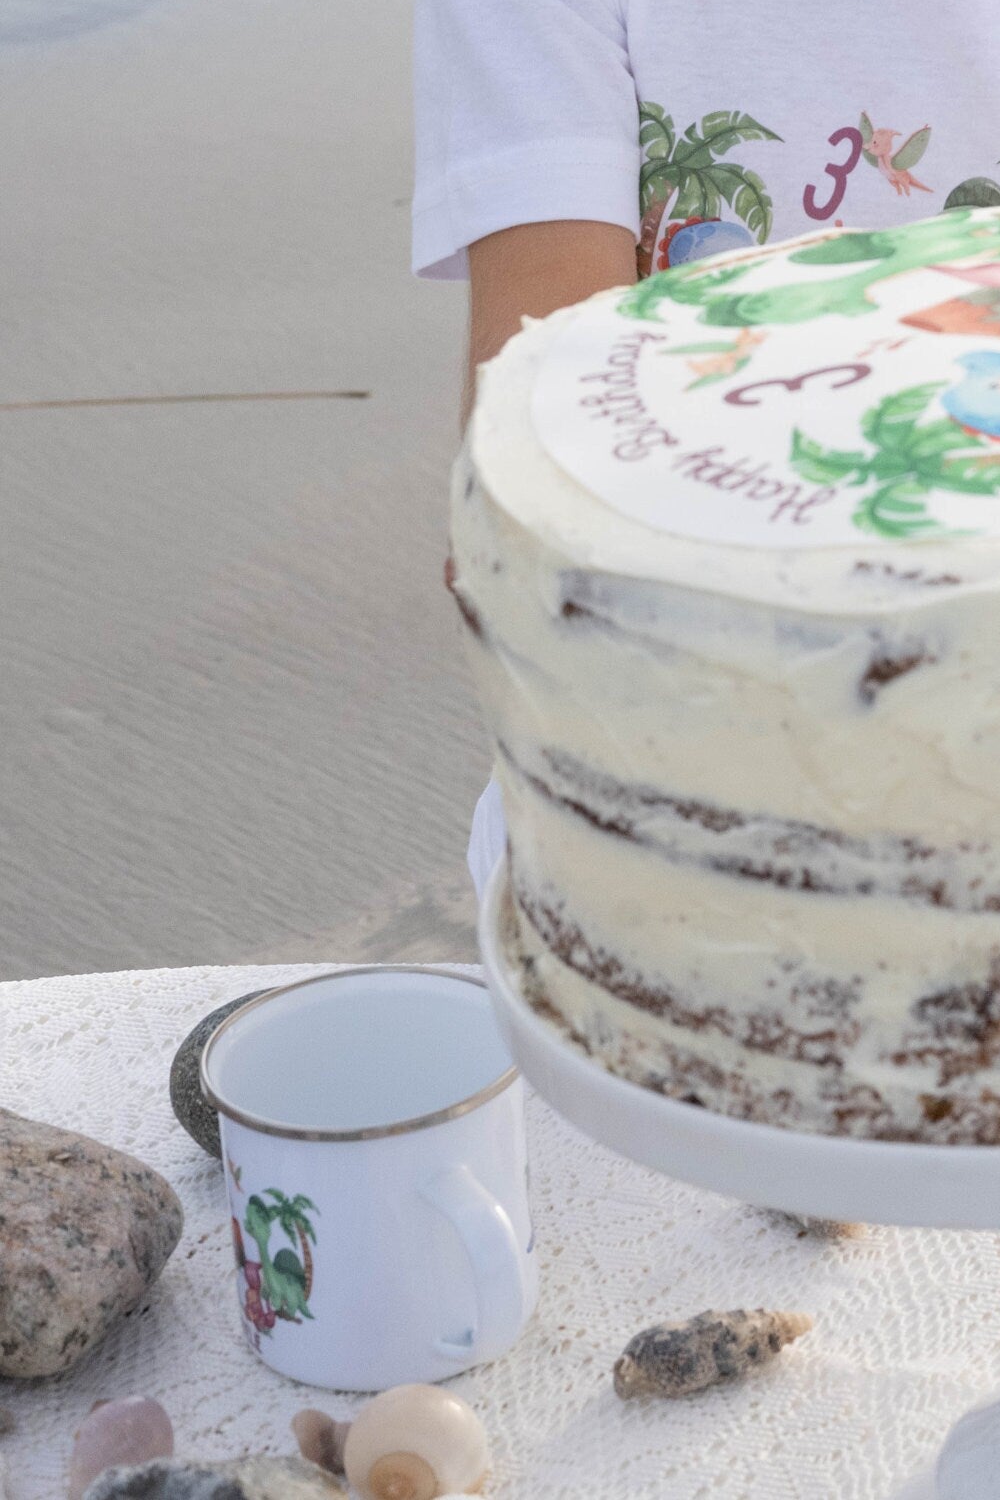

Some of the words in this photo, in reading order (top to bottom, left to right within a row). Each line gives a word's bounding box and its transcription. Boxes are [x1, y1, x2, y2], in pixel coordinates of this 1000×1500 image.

[803, 127, 863, 220] 3
[579, 332, 680, 462] Birthday
[723, 363, 872, 407] 3
[671, 446, 837, 525] Happy
